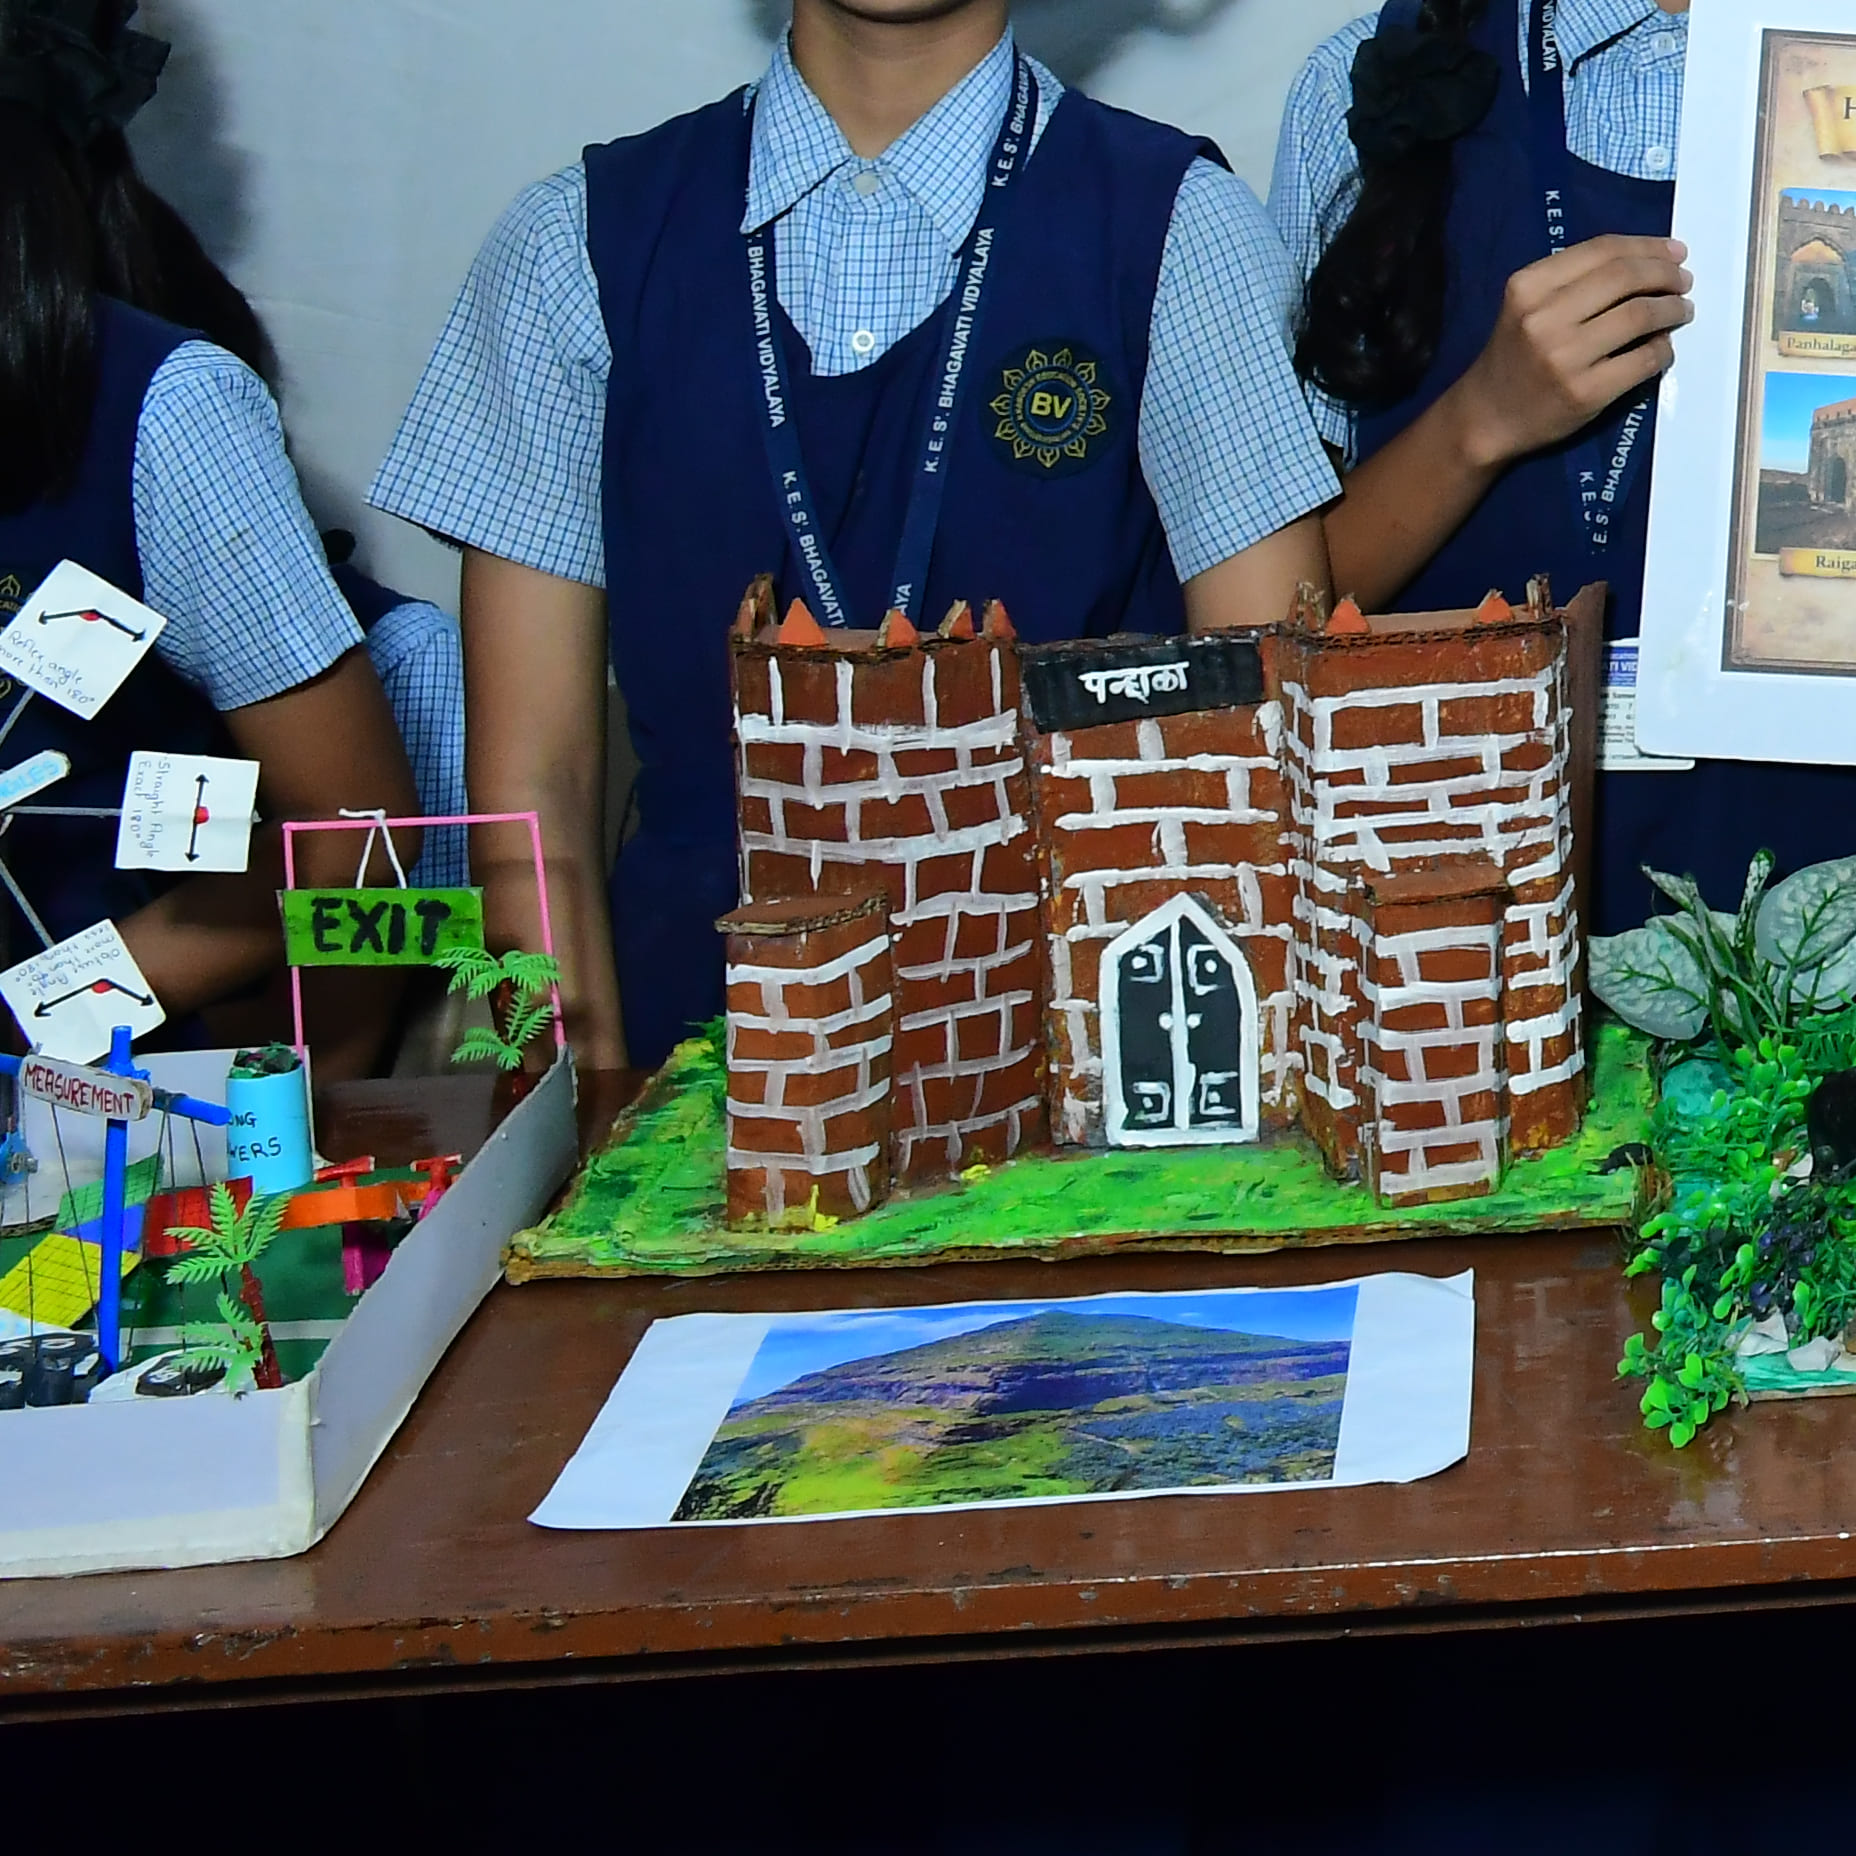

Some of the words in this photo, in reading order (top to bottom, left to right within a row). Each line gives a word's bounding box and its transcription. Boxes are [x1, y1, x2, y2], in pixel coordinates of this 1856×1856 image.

[938, 317, 973, 407] BHAGAVATI
[961, 227, 995, 313] VIDYALAYA
[1031, 392, 1072, 418] BV
[8, 630, 44, 661] Reflex
[48, 659, 83, 686] angle
[311, 897, 452, 956] EXIT
[25, 1064, 134, 1115] MEASUREMENT
